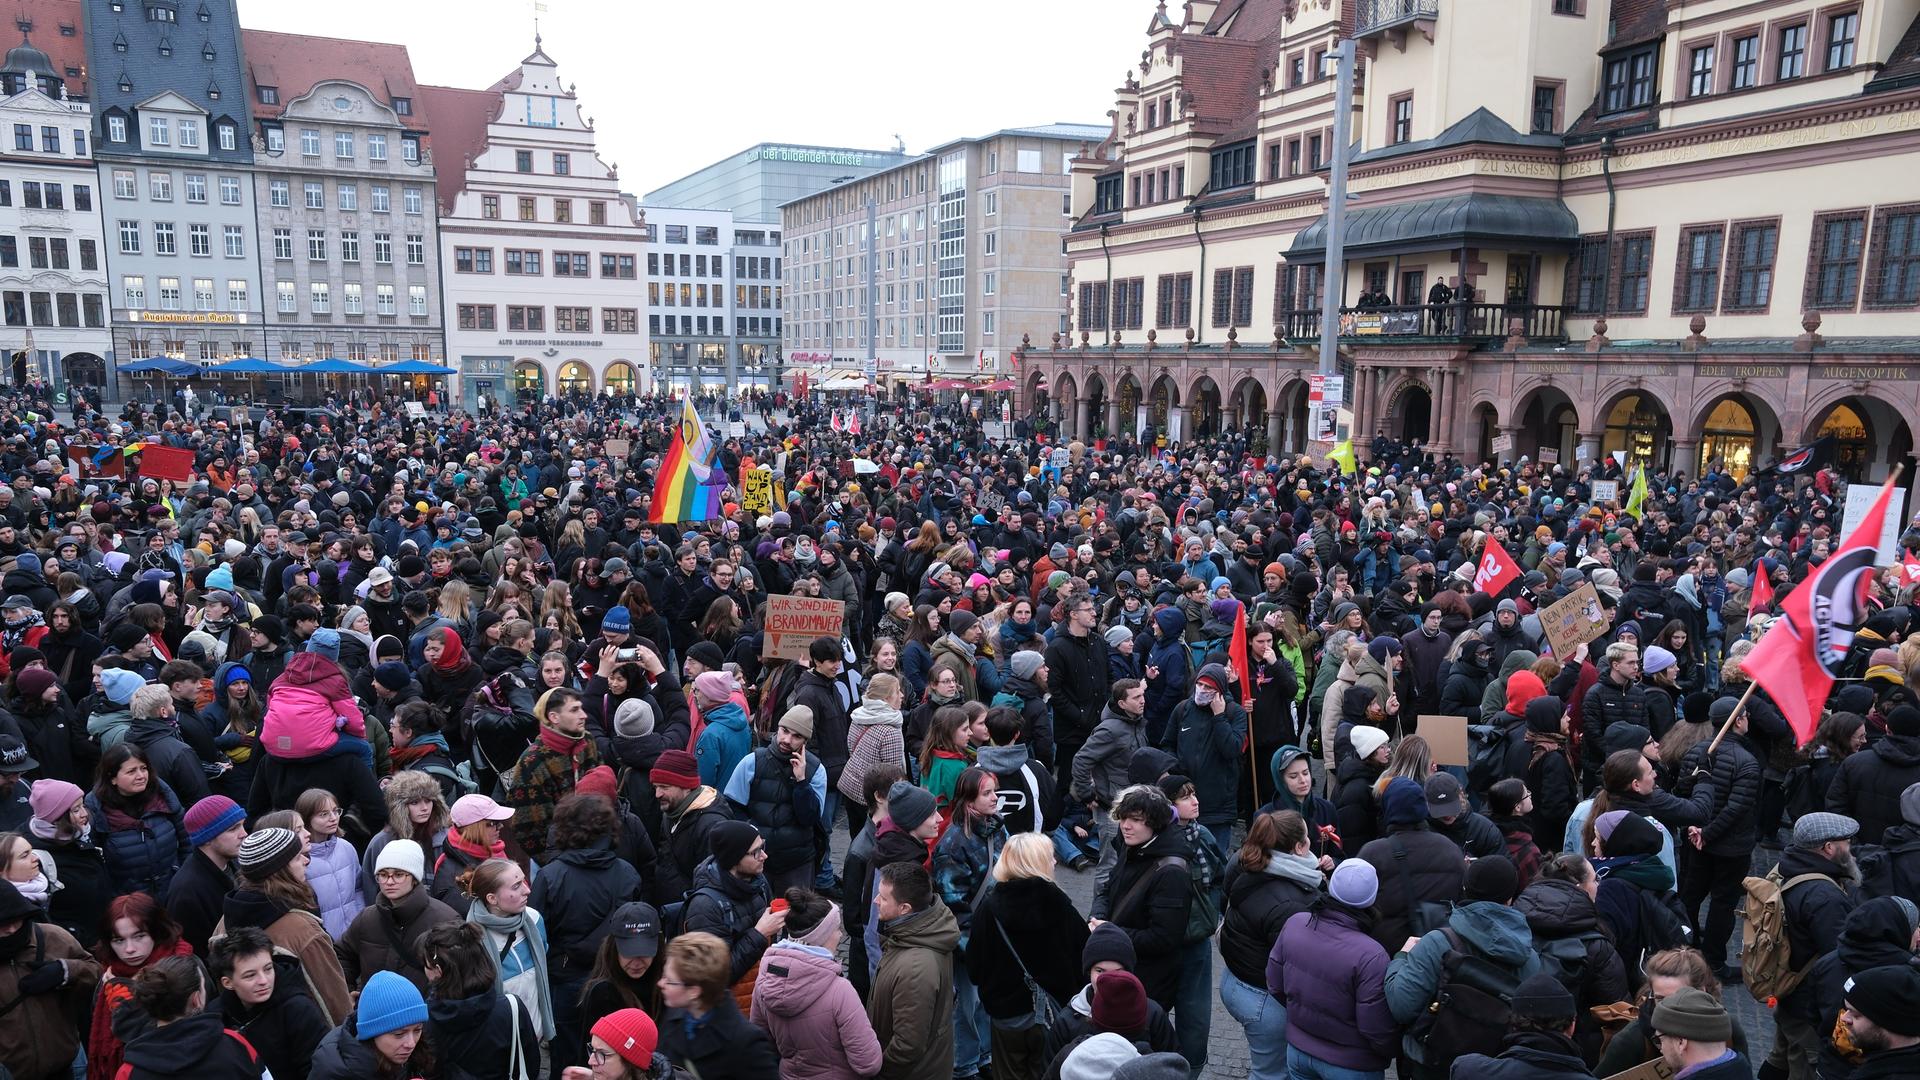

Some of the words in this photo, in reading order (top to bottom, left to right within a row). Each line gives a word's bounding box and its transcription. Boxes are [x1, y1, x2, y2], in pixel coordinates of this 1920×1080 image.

[763, 148, 779, 160] der
[782, 149, 827, 164] bildenden
[1481, 160, 1498, 173] ZU
[1504, 162, 1556, 177] SACHSEN
[1571, 163, 1592, 176] DES
[1700, 366, 1727, 376] EDLE
[1735, 366, 1785, 377] TROPFEN
[1822, 367, 1908, 379] AUGENOPTIK
[748, 471, 770, 482] WAKE
[746, 482, 768, 492] UP
[771, 599, 791, 610] WIR
[794, 600, 820, 611] SIND
[822, 601, 839, 613] DIE
[772, 614, 842, 631] BRANDMAUER
[1544, 609, 1560, 624] NEIN
[1562, 623, 1579, 640] KEINE
[1557, 626, 1594, 656] Alternative!
